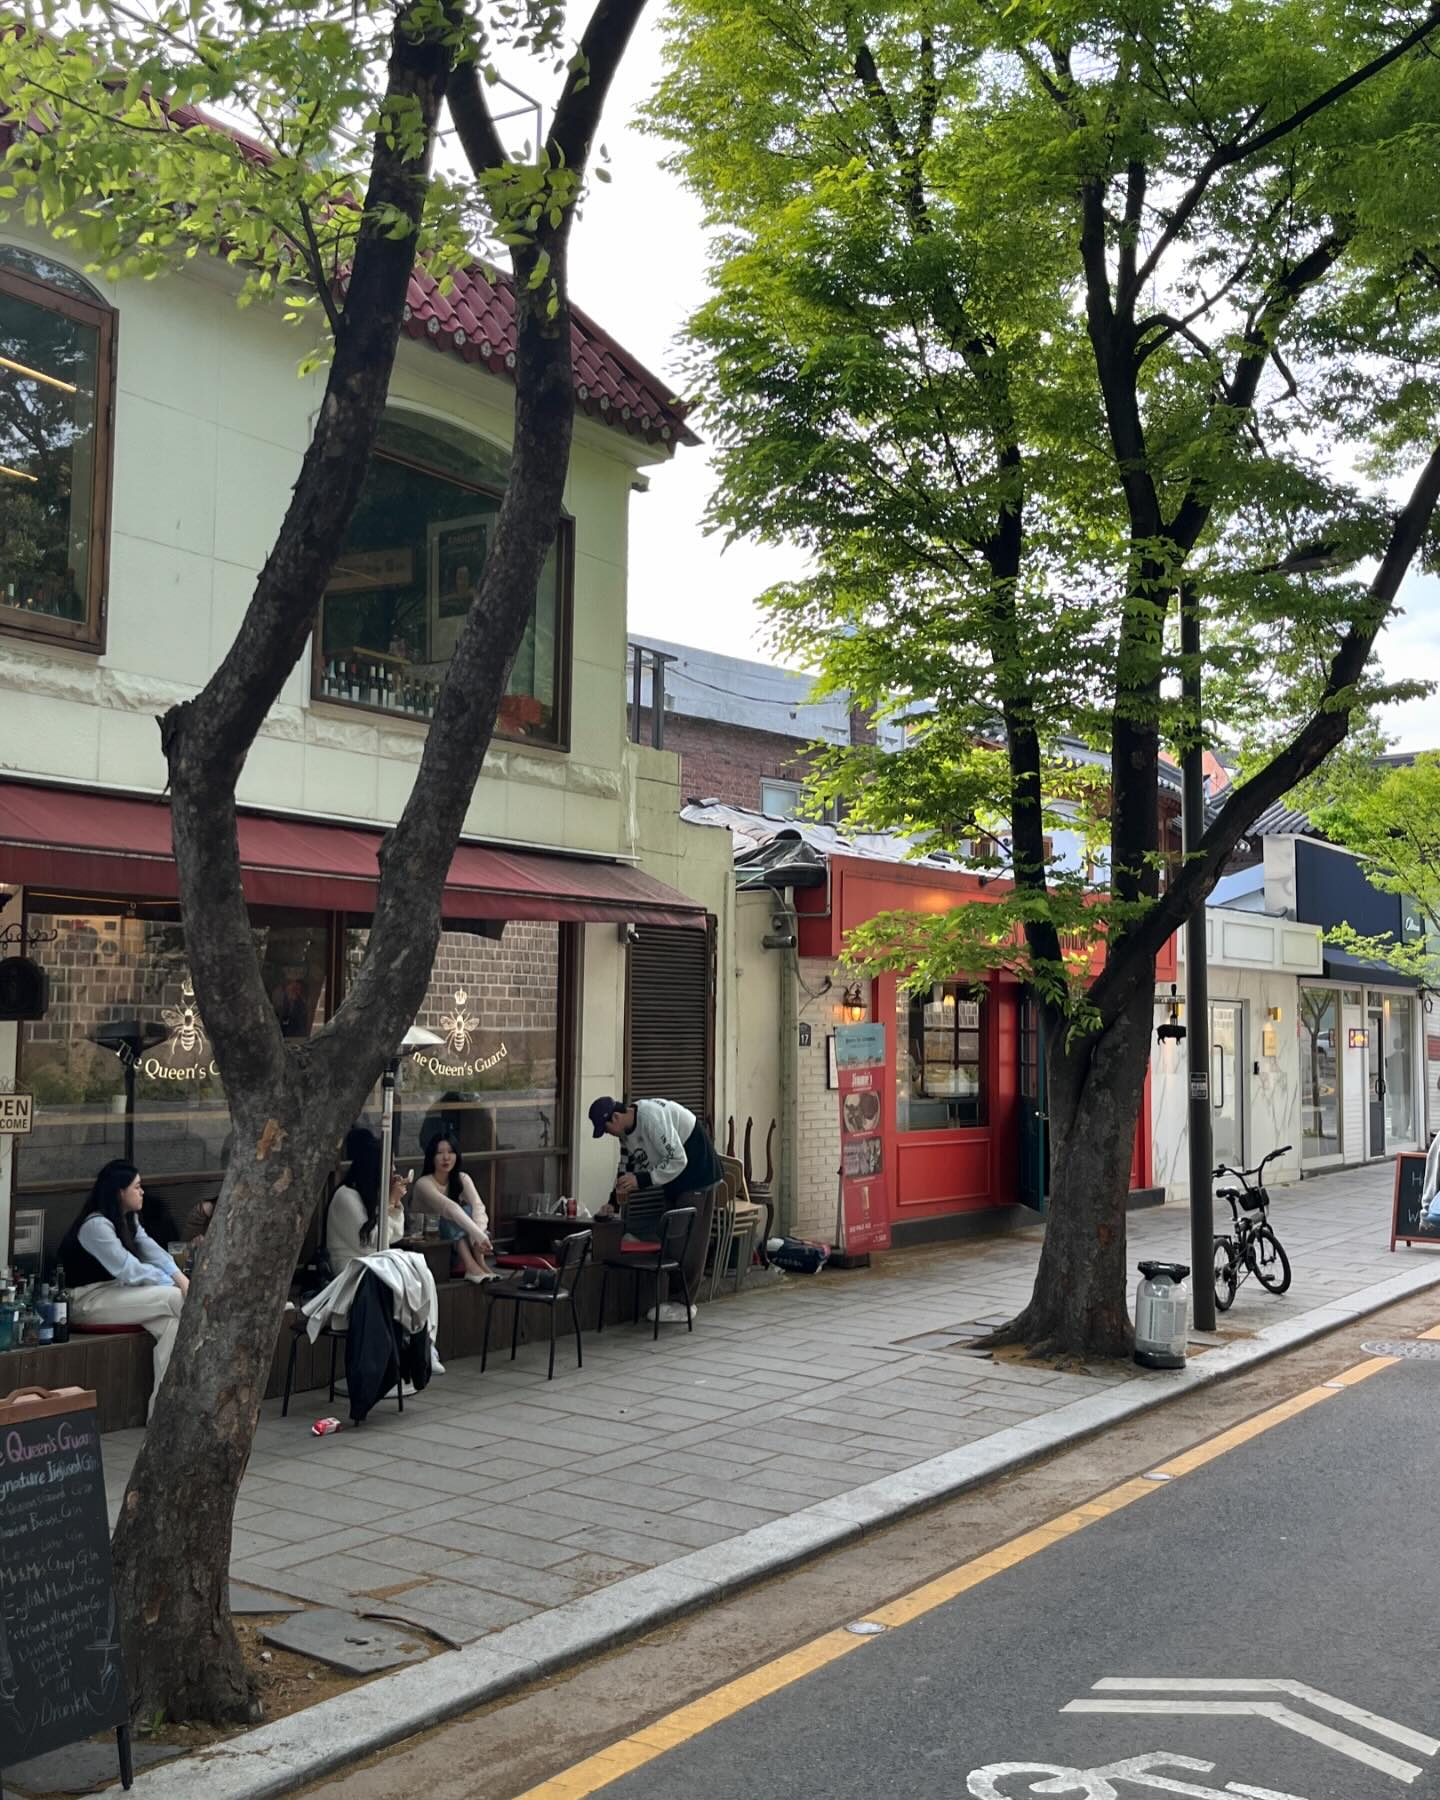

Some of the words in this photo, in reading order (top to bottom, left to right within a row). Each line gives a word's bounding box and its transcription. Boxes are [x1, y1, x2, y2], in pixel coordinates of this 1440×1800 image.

[144, 1058, 207, 1080] Queen's
[410, 1043, 427, 1067] he
[428, 1057, 473, 1076] Queen's
[474, 1042, 508, 1073] Guard
[0, 1100, 28, 1116] EN
[6, 1431, 57, 1463] Queen's
